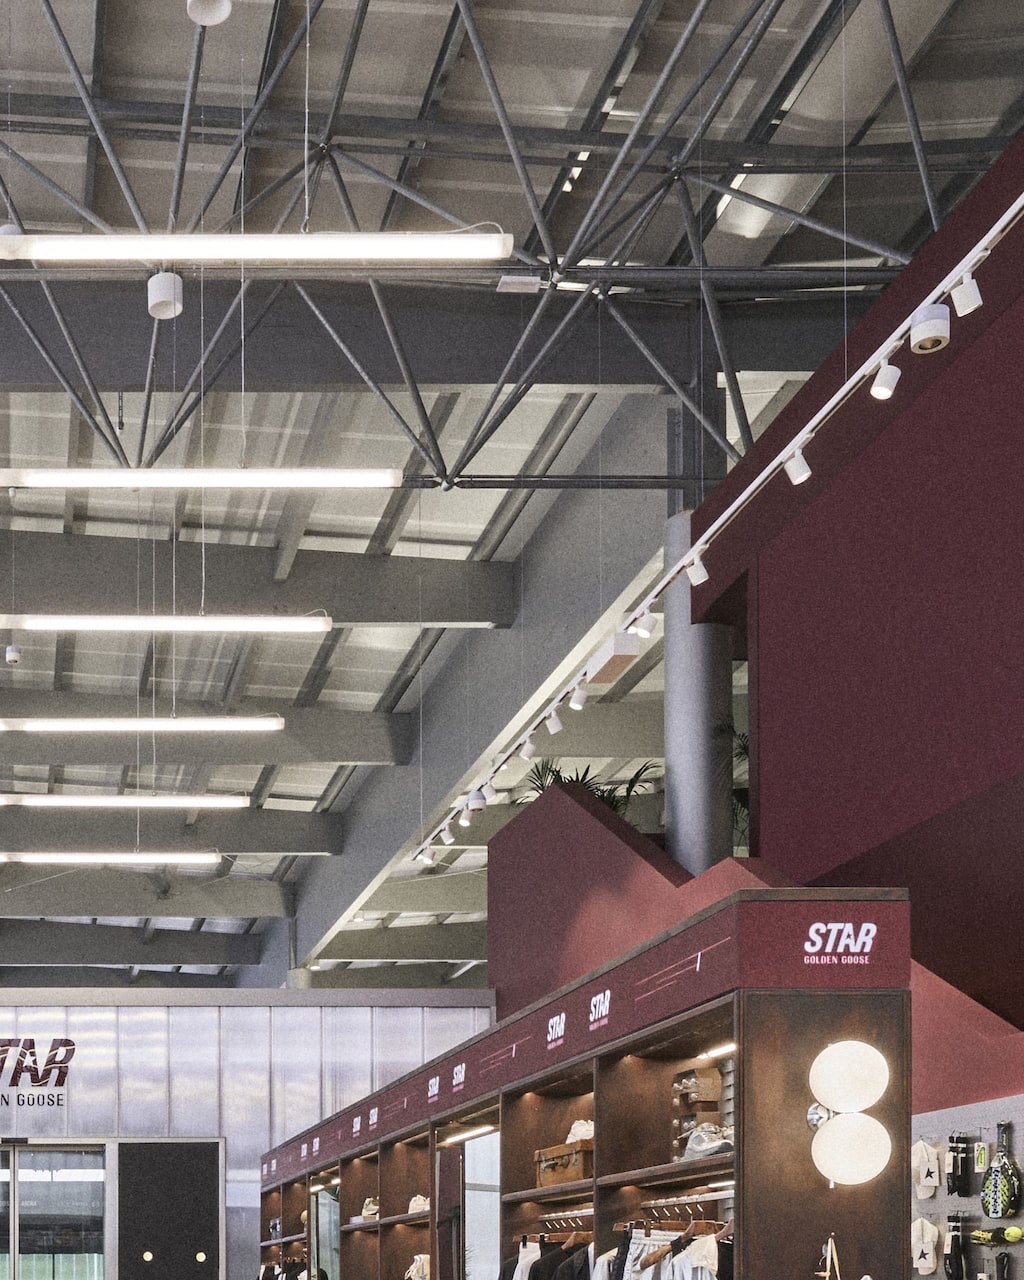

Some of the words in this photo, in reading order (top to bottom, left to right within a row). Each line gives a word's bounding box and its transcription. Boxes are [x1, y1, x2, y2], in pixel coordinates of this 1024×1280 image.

[804, 922, 877, 953] STAR
[804, 955, 838, 965] GOLDEN
[841, 955, 870, 965] GOOSE
[589, 989, 611, 1022] STAR
[547, 1012, 566, 1042] STAR
[17, 1093, 64, 1107] GOOSE
